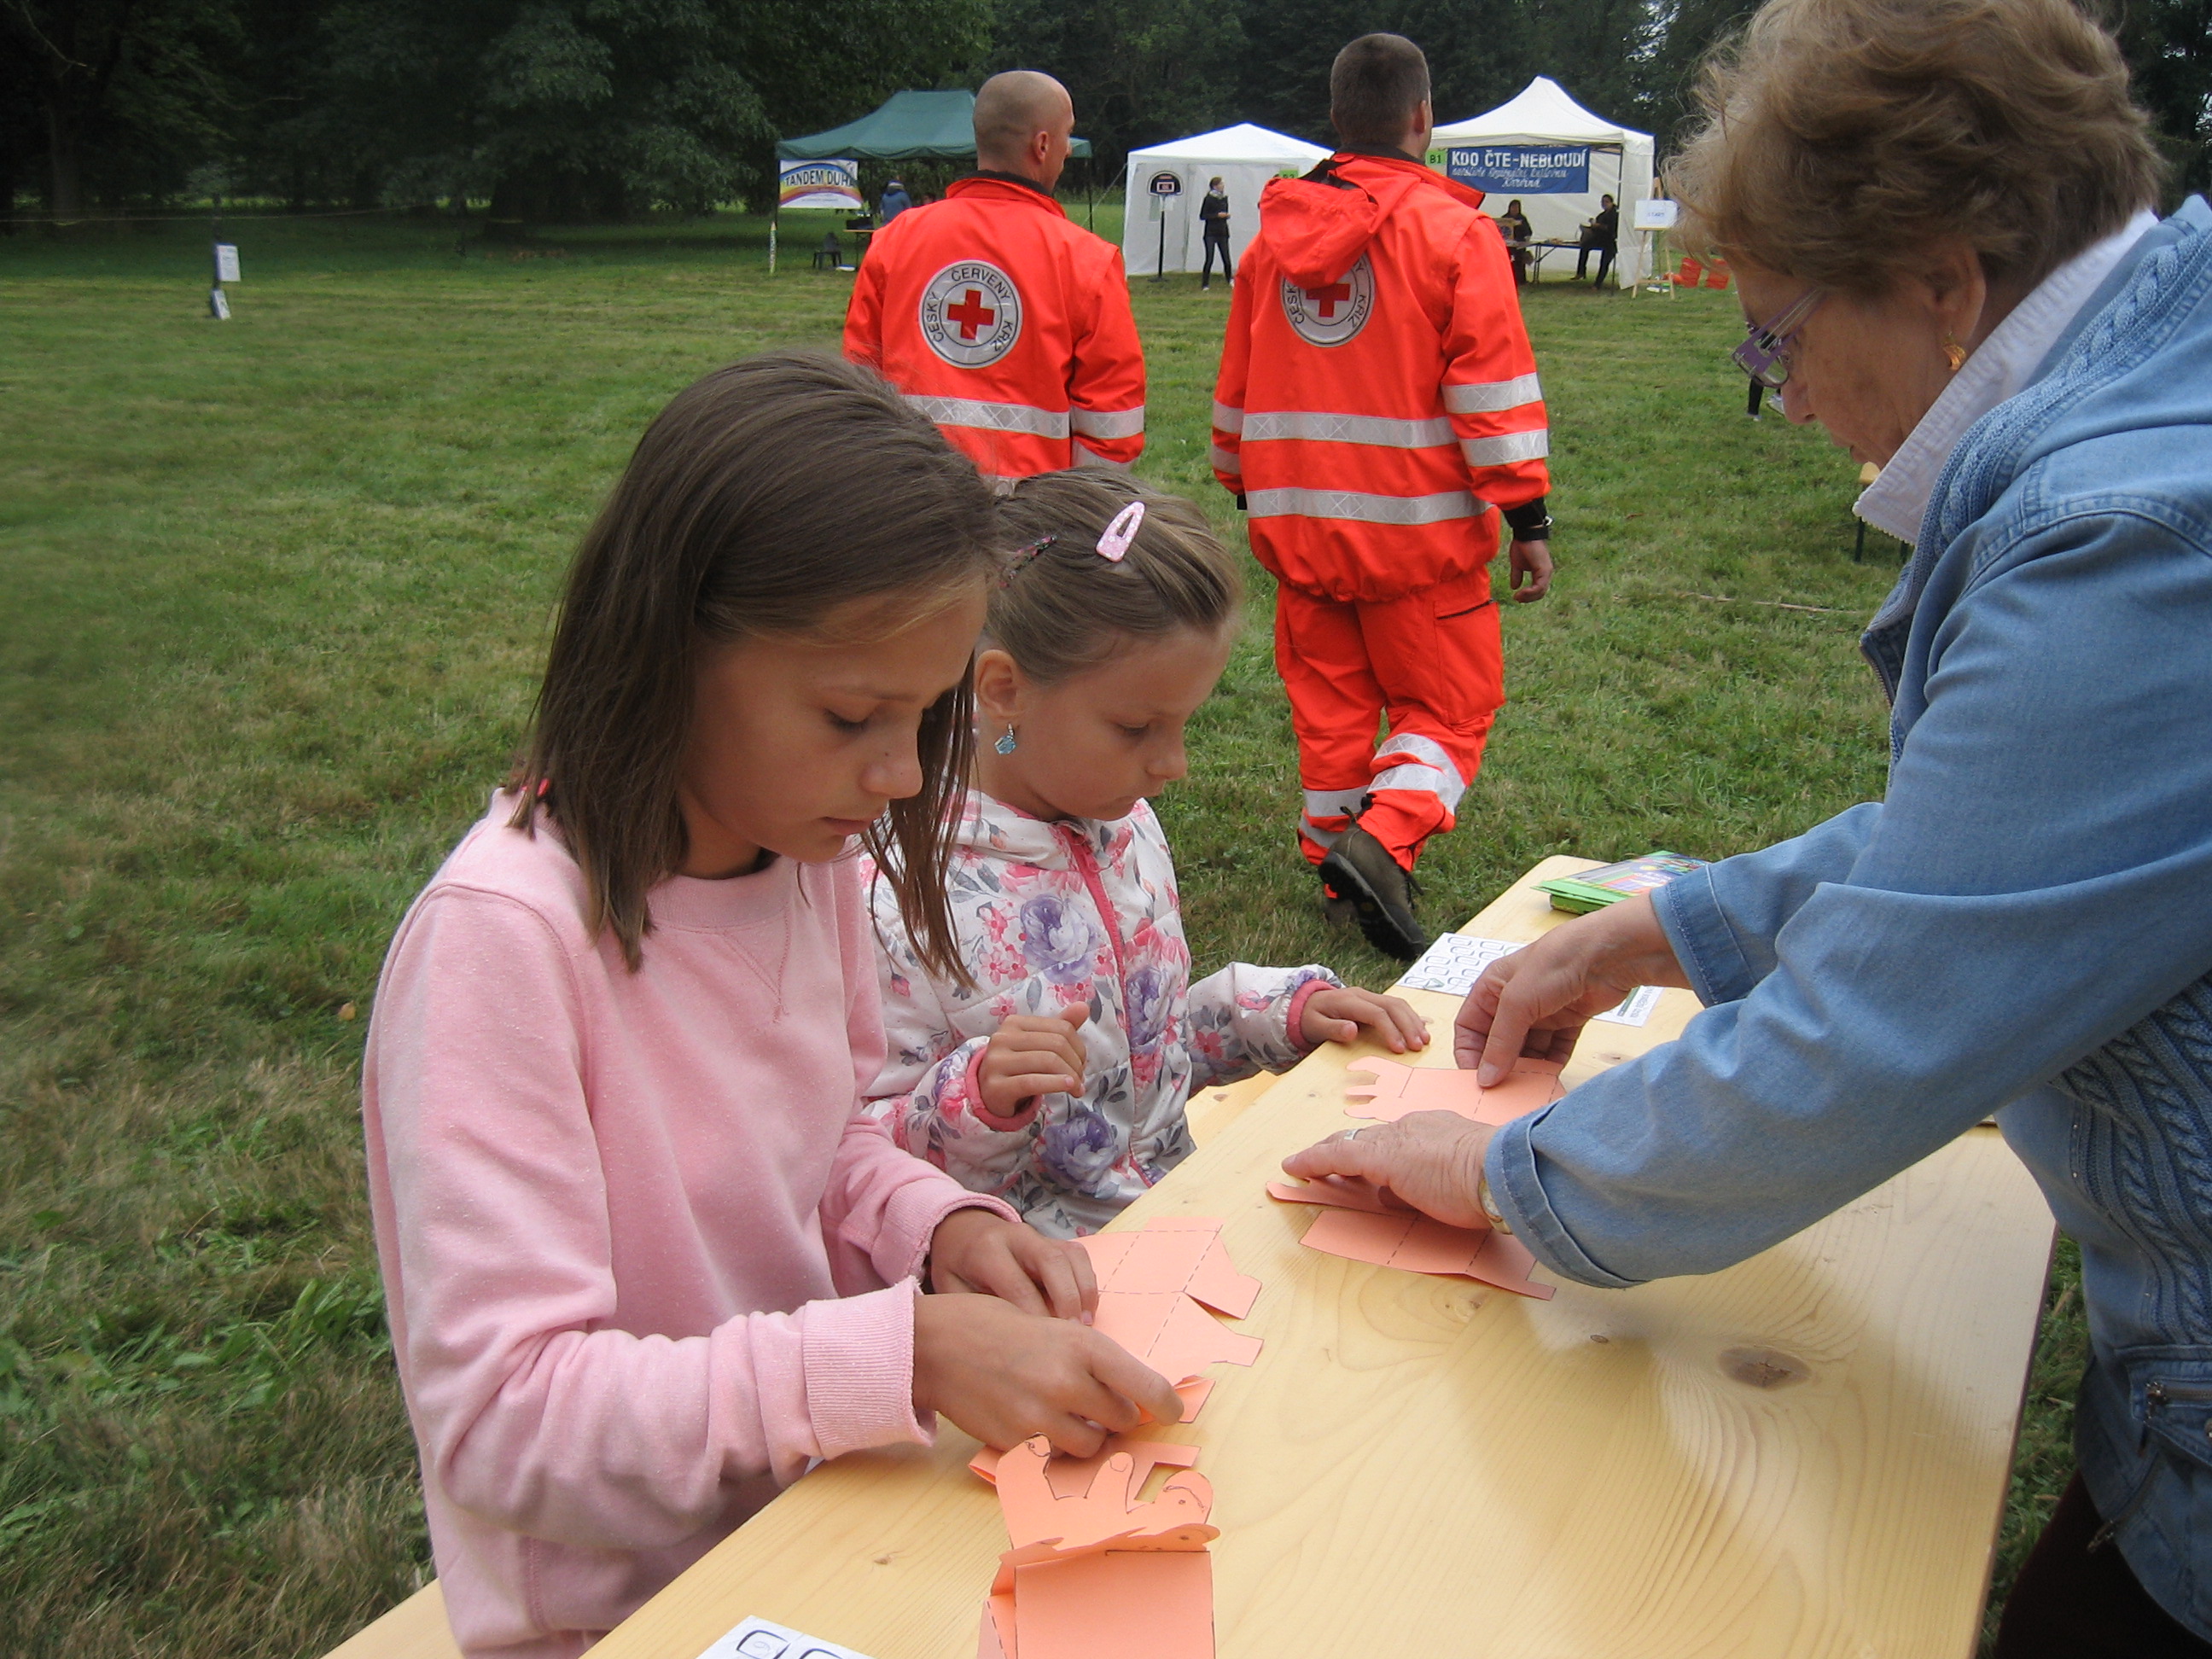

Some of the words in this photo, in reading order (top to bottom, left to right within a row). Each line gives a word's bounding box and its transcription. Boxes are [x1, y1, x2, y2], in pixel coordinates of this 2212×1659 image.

[1429, 154, 1442, 164] B1
[1452, 150, 1479, 166] KDO
[785, 170, 824, 186] TANDEM
